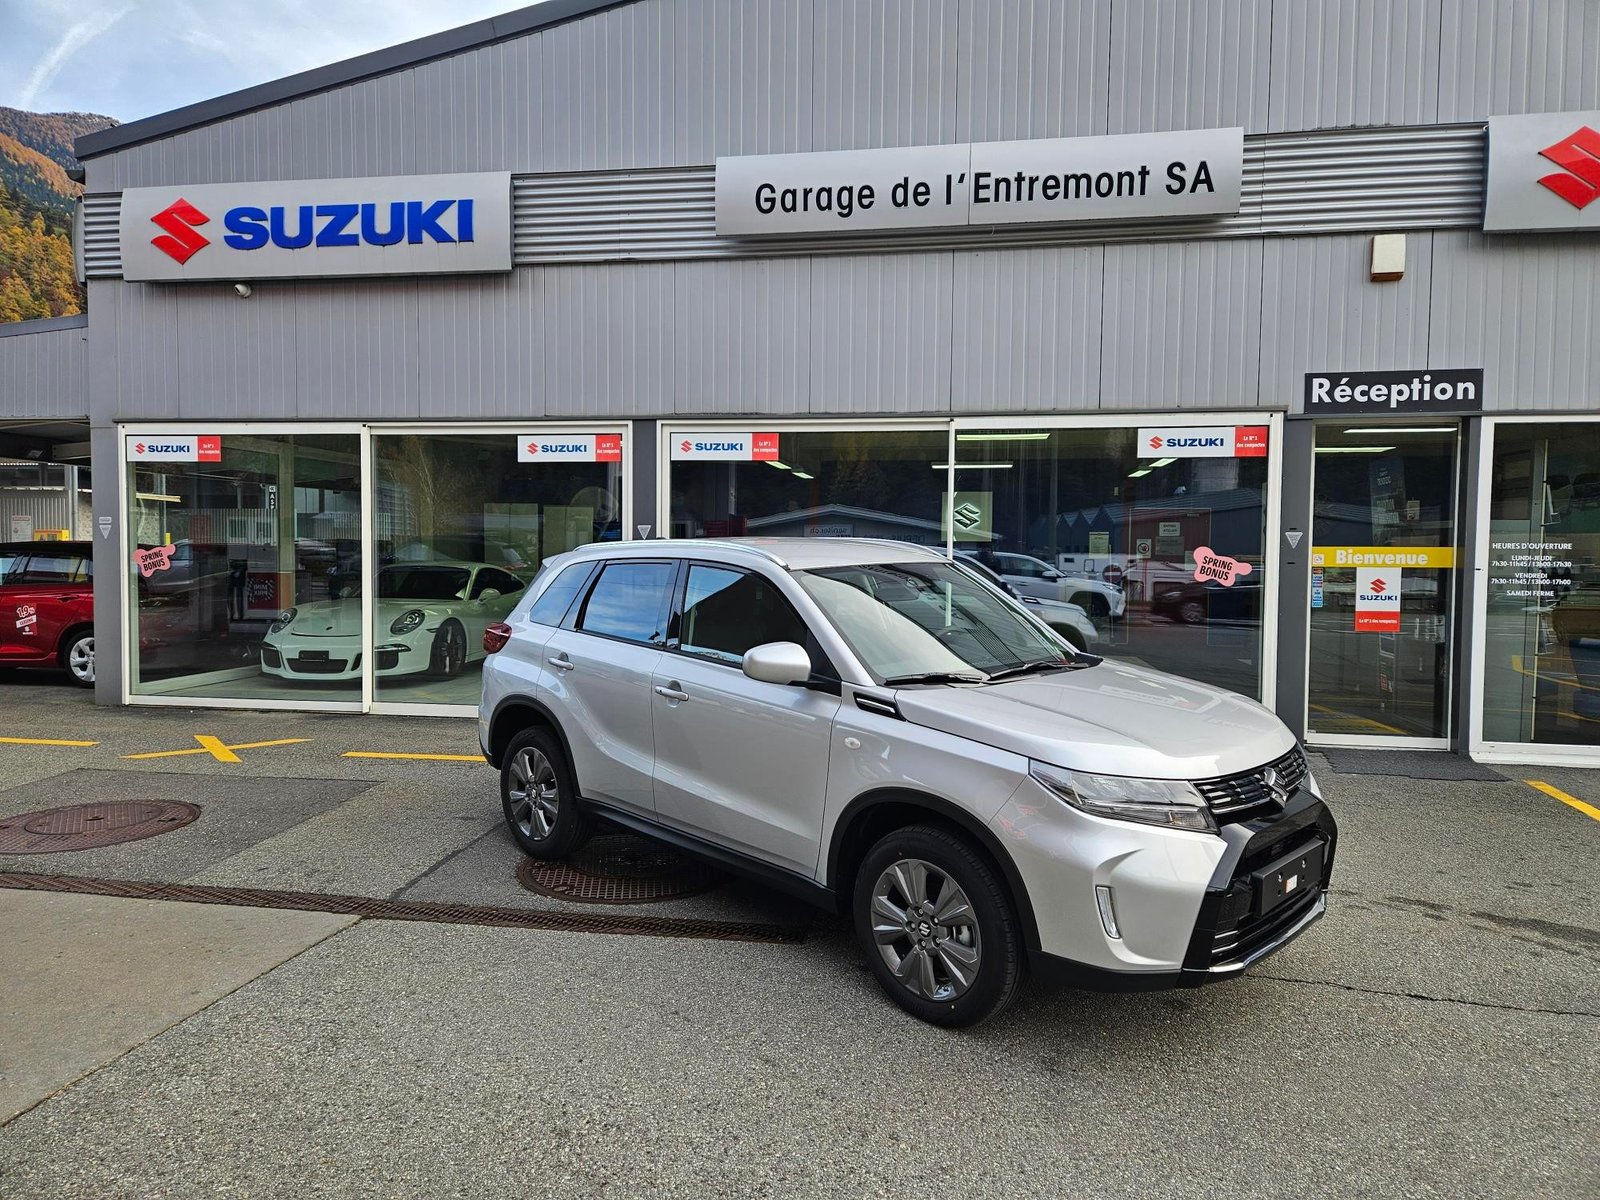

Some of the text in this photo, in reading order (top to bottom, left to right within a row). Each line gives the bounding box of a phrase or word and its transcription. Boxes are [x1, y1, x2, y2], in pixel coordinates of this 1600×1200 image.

[755, 183, 875, 218] Garage
[891, 176, 931, 208] de
[1165, 160, 1215, 195] SA
[223, 199, 474, 250] SUZUKI
[1311, 374, 1476, 409] Réception
[541, 444, 587, 452] SUZUKI
[695, 442, 743, 451] SUZUKI
[1166, 438, 1224, 447] SUZUKI
[140, 550, 163, 563] SPRING
[1202, 556, 1233, 571] SPRING
[1335, 548, 1428, 565] Bienvenue
[143, 558, 165, 571] BONUS
[1199, 566, 1230, 581] BONUS
